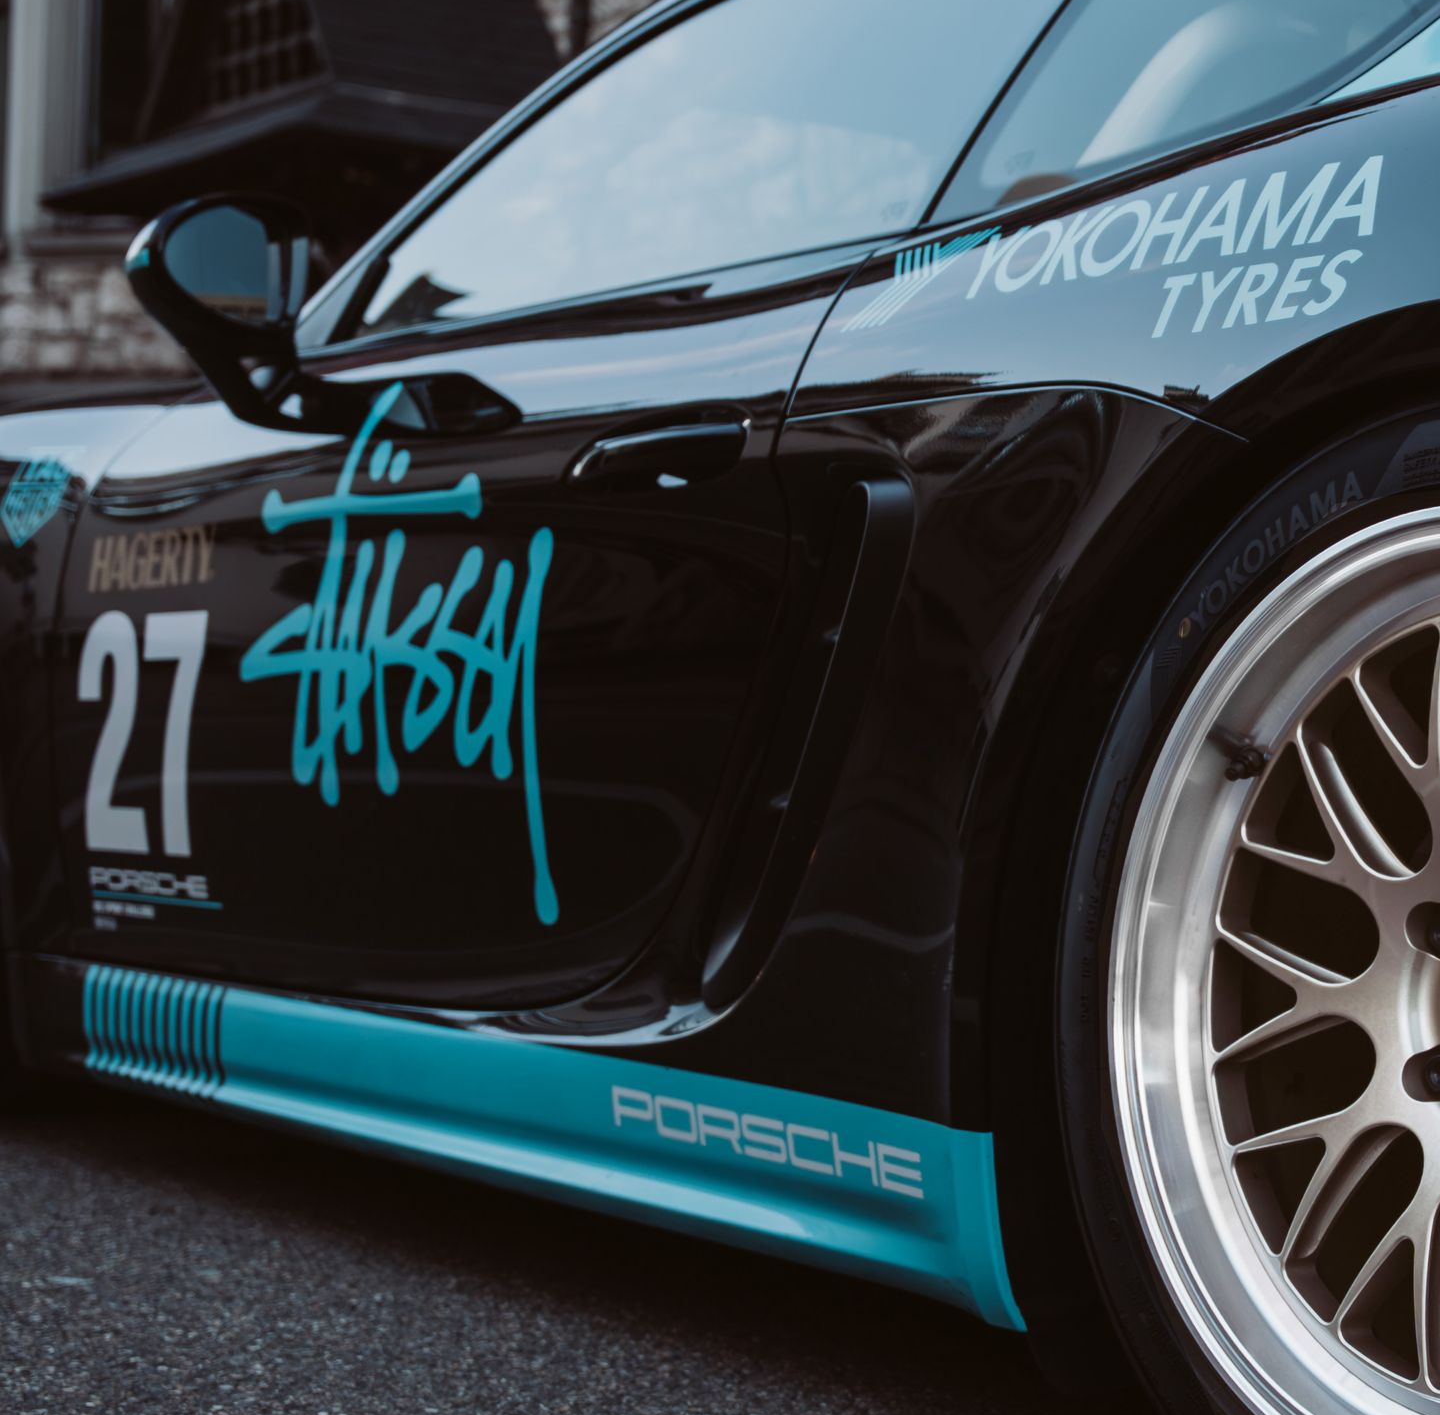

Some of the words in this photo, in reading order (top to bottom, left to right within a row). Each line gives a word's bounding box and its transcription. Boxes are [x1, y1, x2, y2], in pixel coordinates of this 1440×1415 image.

[965, 155, 1384, 300] YOKOHAMA
[1151, 249, 1363, 339] TYRES
[88, 524, 217, 593] HAGERTY
[1190, 470, 1365, 630] YOKOHAMA
[77, 609, 209, 858] 27
[89, 866, 210, 900] PORSCHE
[611, 1085, 924, 1199] PORSCHE
